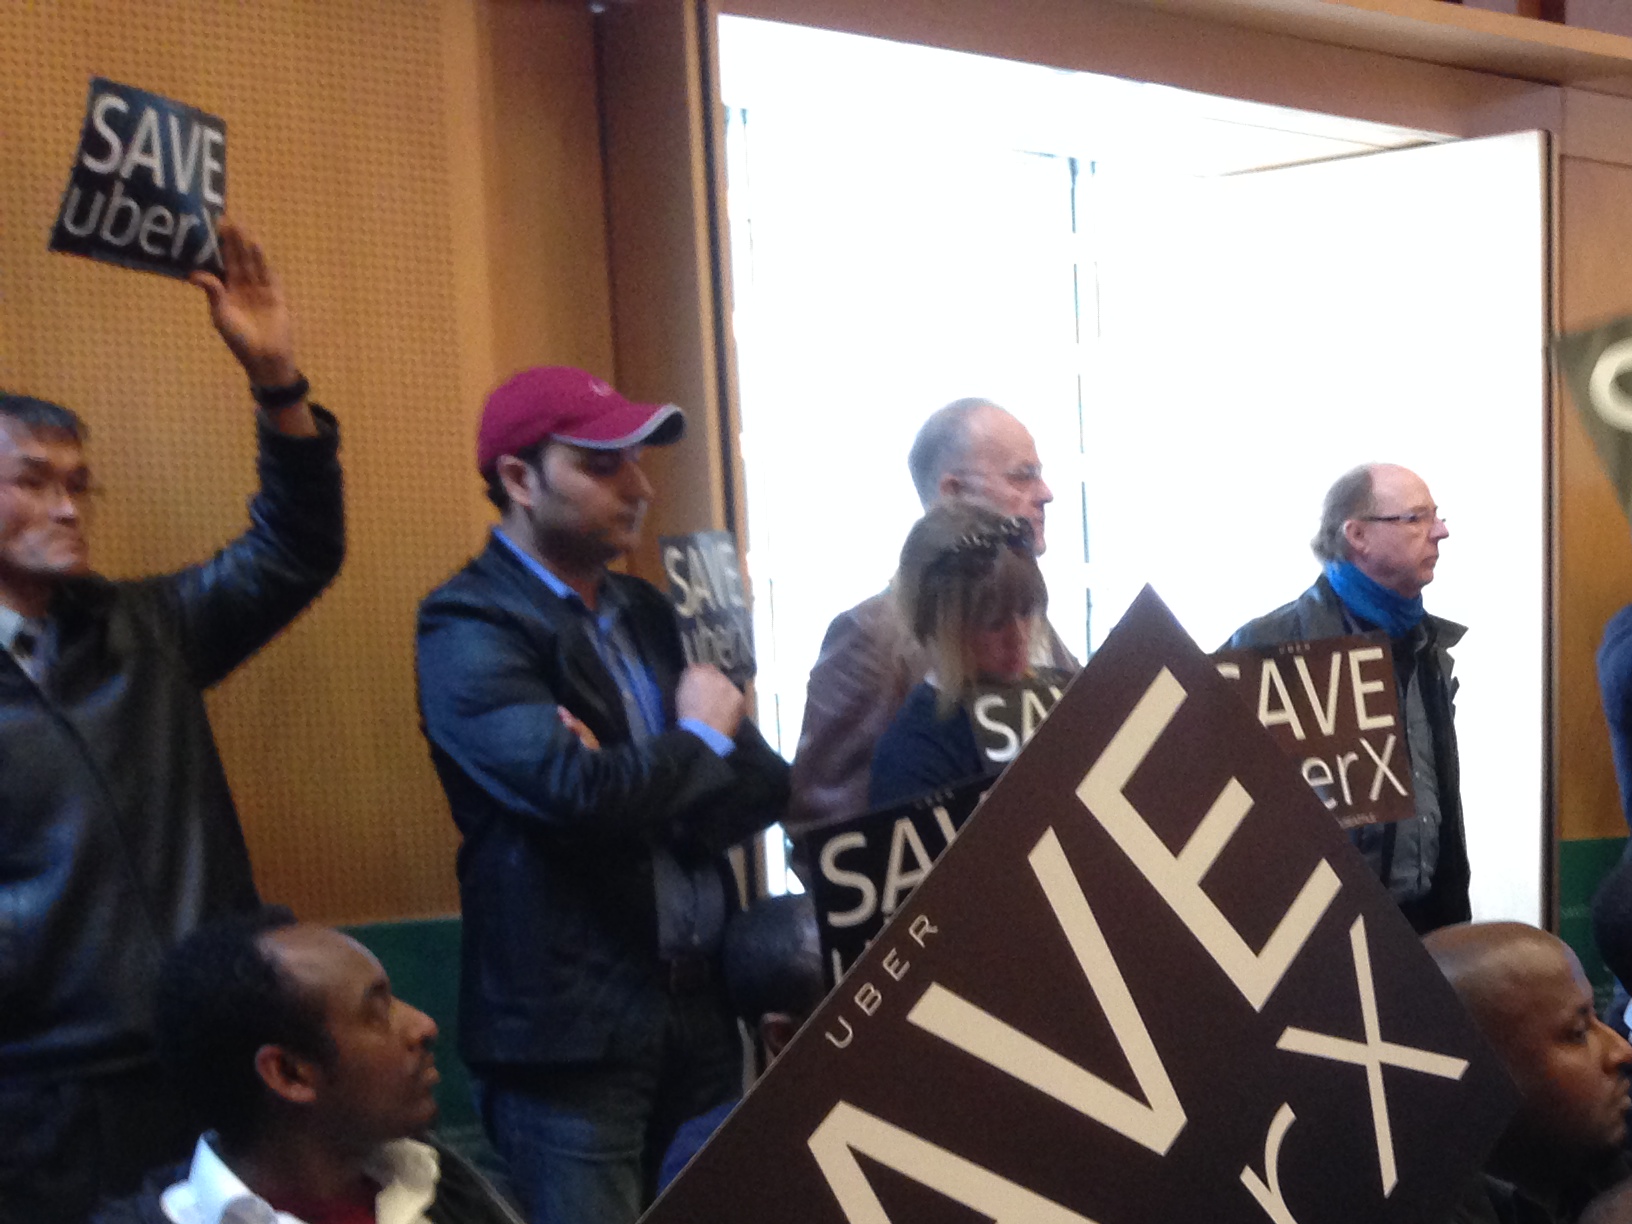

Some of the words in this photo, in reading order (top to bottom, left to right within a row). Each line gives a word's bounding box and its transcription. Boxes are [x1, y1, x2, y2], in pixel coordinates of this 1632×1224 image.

[82, 93, 225, 210] SAVE
[973, 685, 1065, 763] SA
[1216, 647, 1396, 741] AVE
[1300, 733, 1409, 810] erX
[818, 805, 958, 929] SA
[824, 914, 939, 1050] UBER
